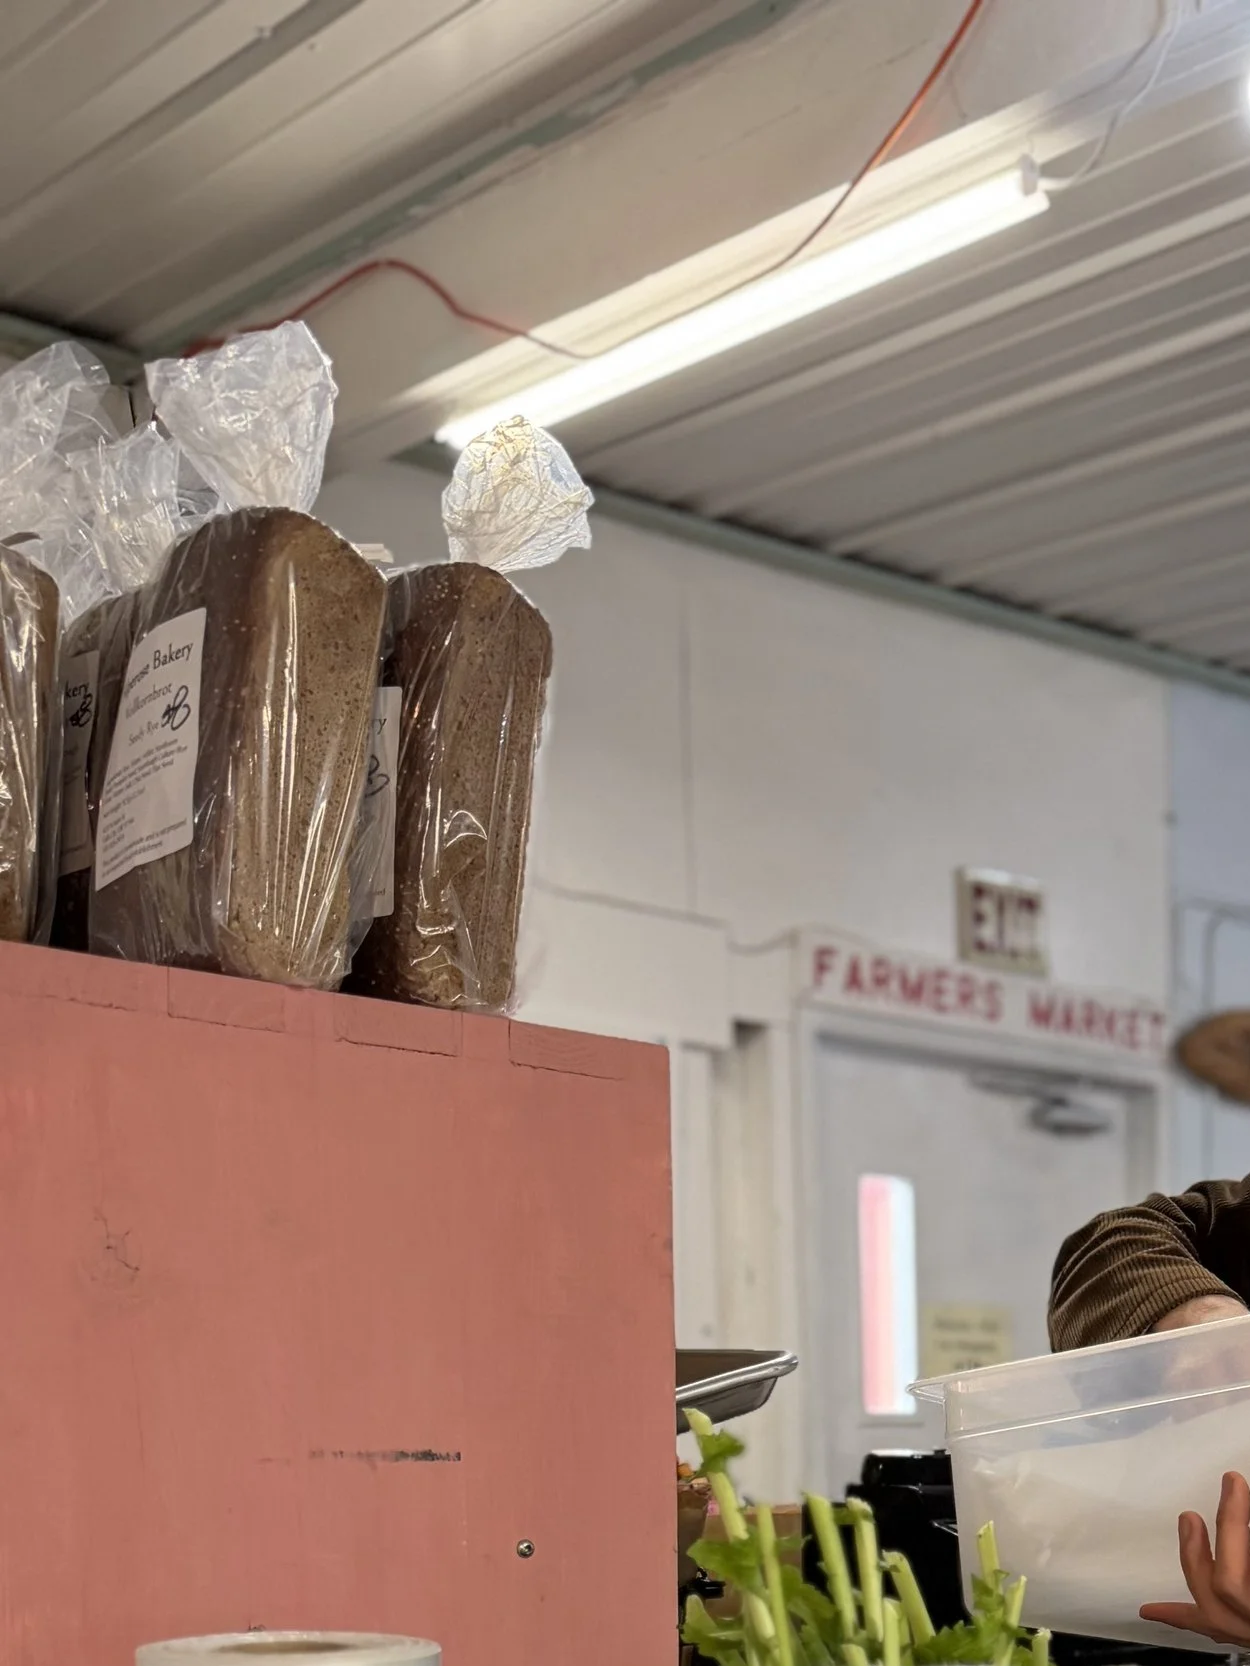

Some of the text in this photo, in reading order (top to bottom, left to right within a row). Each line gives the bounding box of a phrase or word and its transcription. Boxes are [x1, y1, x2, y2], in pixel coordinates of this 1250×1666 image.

[153, 643, 194, 671] Bakery
[971, 880, 1043, 961] EXIT
[813, 944, 1167, 1052] FARMERS MARKET
